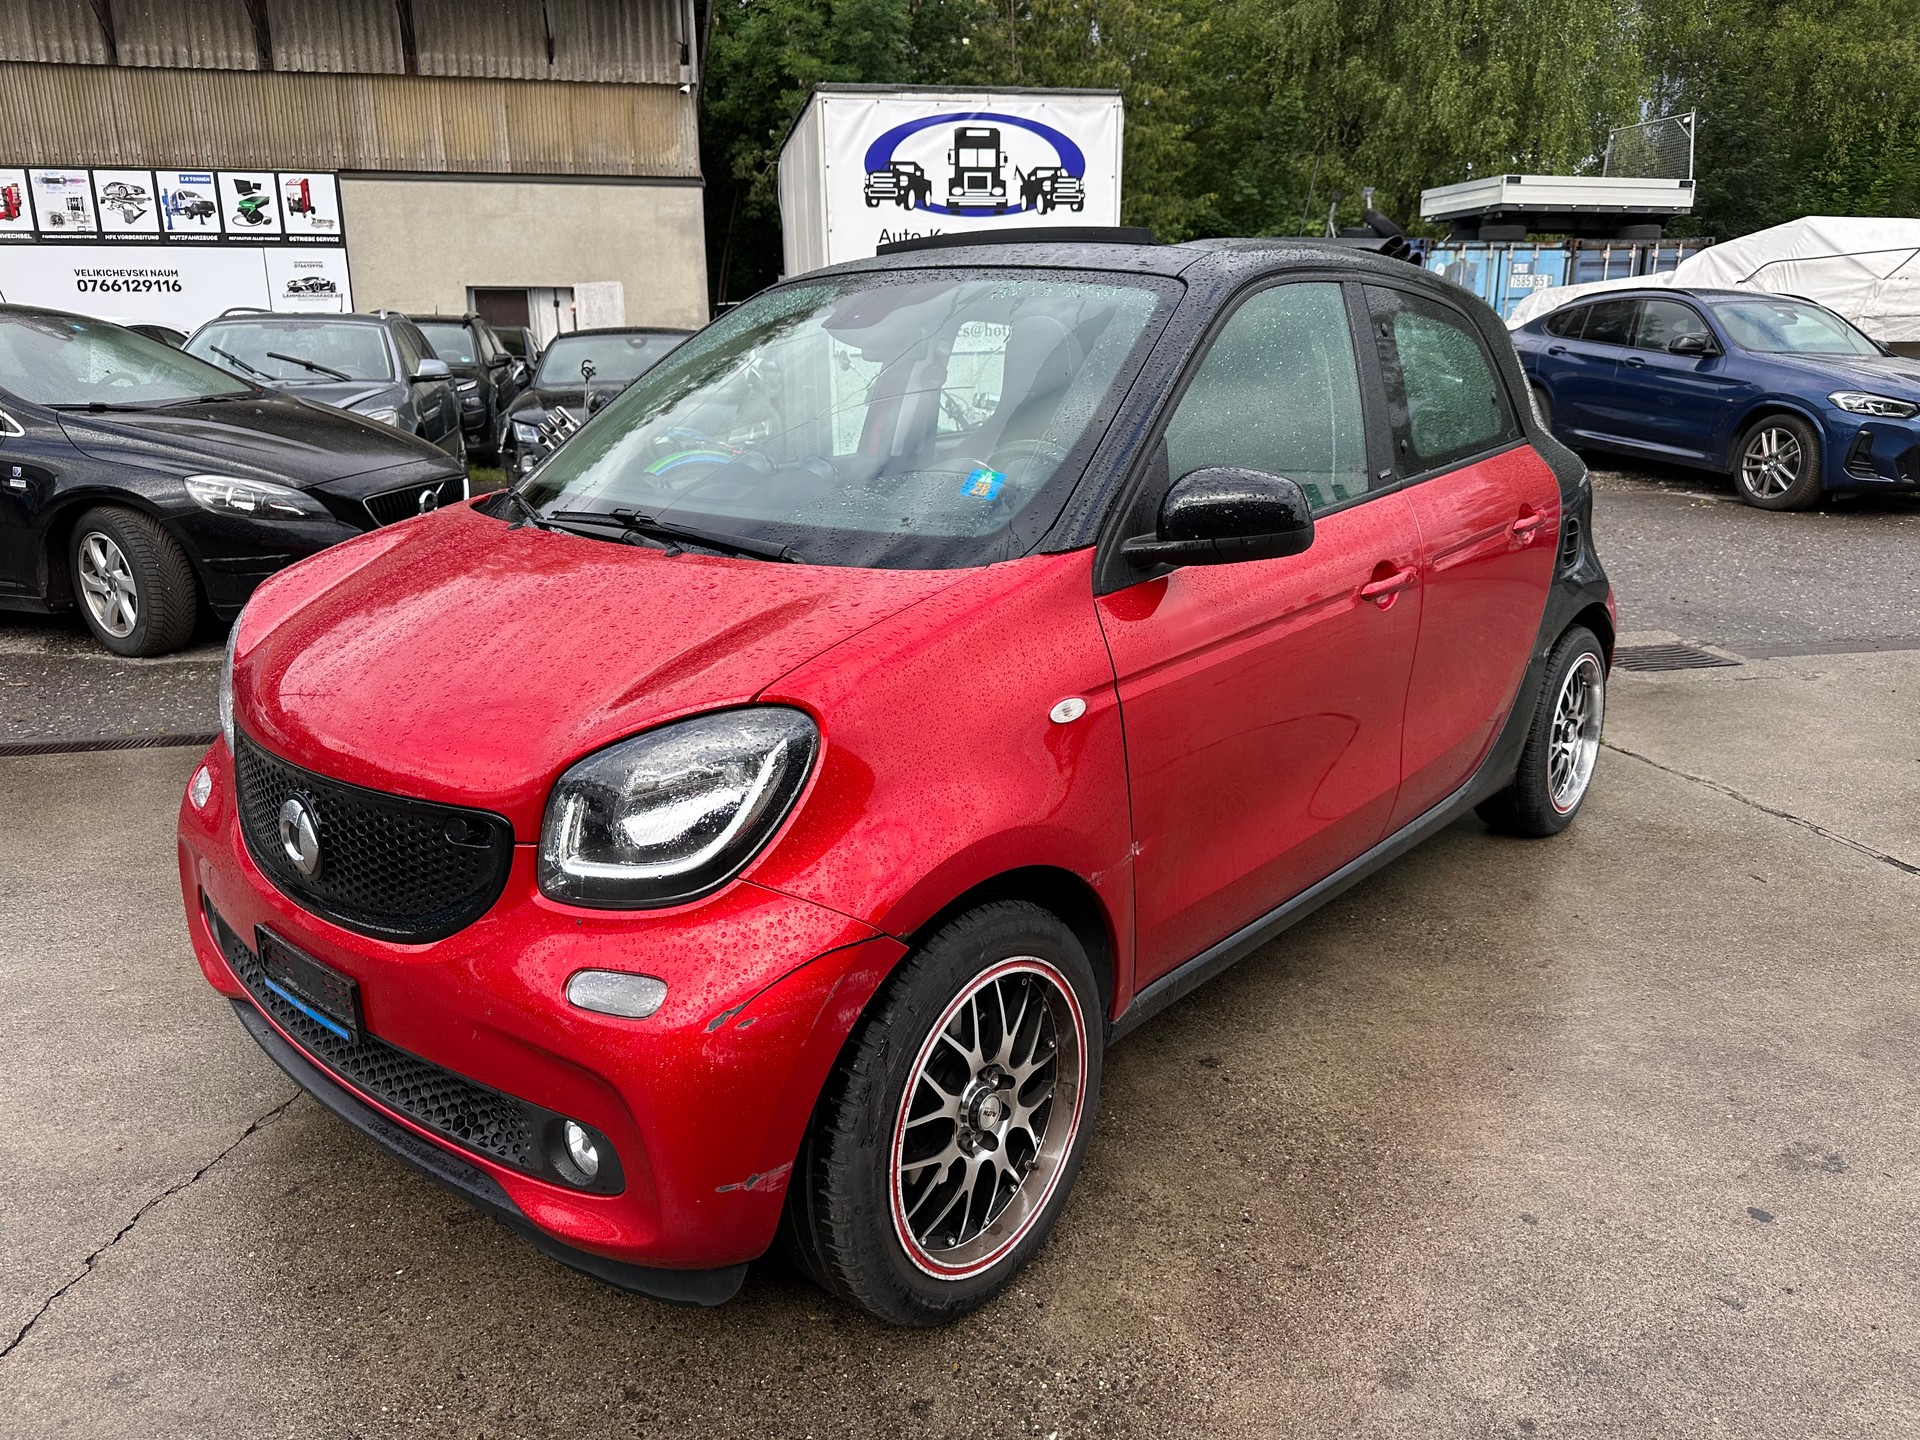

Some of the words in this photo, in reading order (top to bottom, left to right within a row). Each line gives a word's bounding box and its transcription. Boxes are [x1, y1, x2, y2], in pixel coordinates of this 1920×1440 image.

[878, 228, 921, 244] Auto
[74, 269, 148, 277] VELIKICHEVSKI
[150, 269, 179, 277] NAUM
[77, 279, 182, 293] 0766129116
